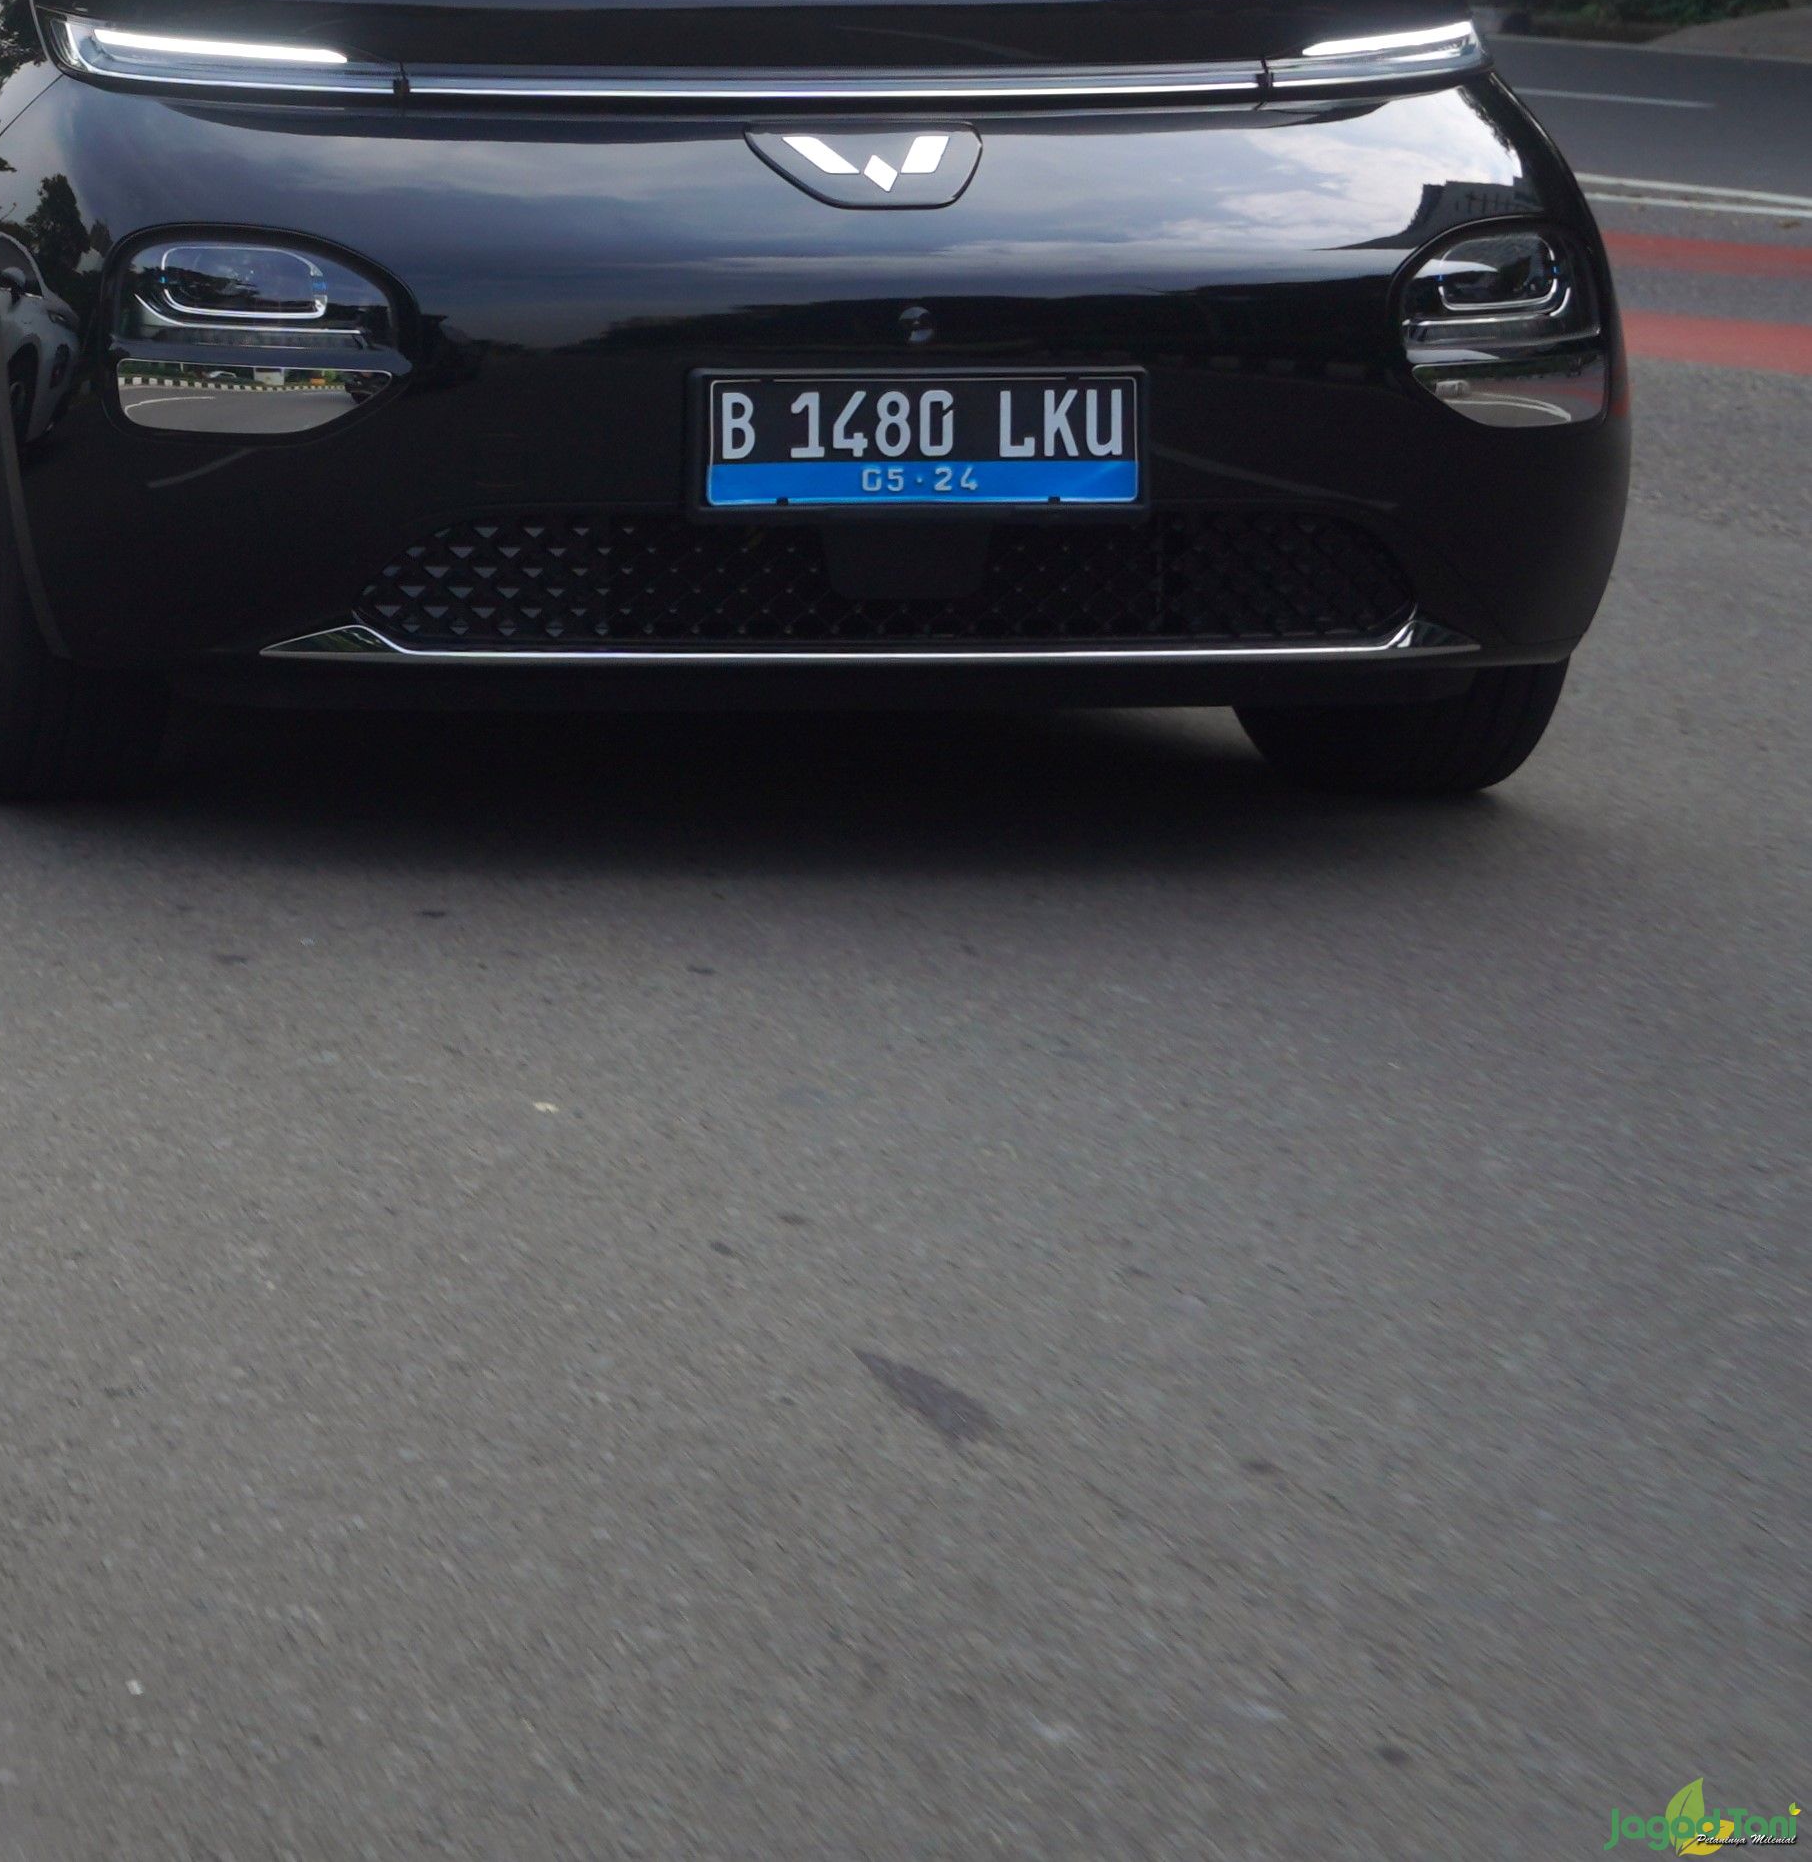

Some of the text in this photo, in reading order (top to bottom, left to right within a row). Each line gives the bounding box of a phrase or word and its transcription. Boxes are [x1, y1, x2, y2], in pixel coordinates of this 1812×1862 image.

[721, 388, 1123, 460] B 1480 LKU
